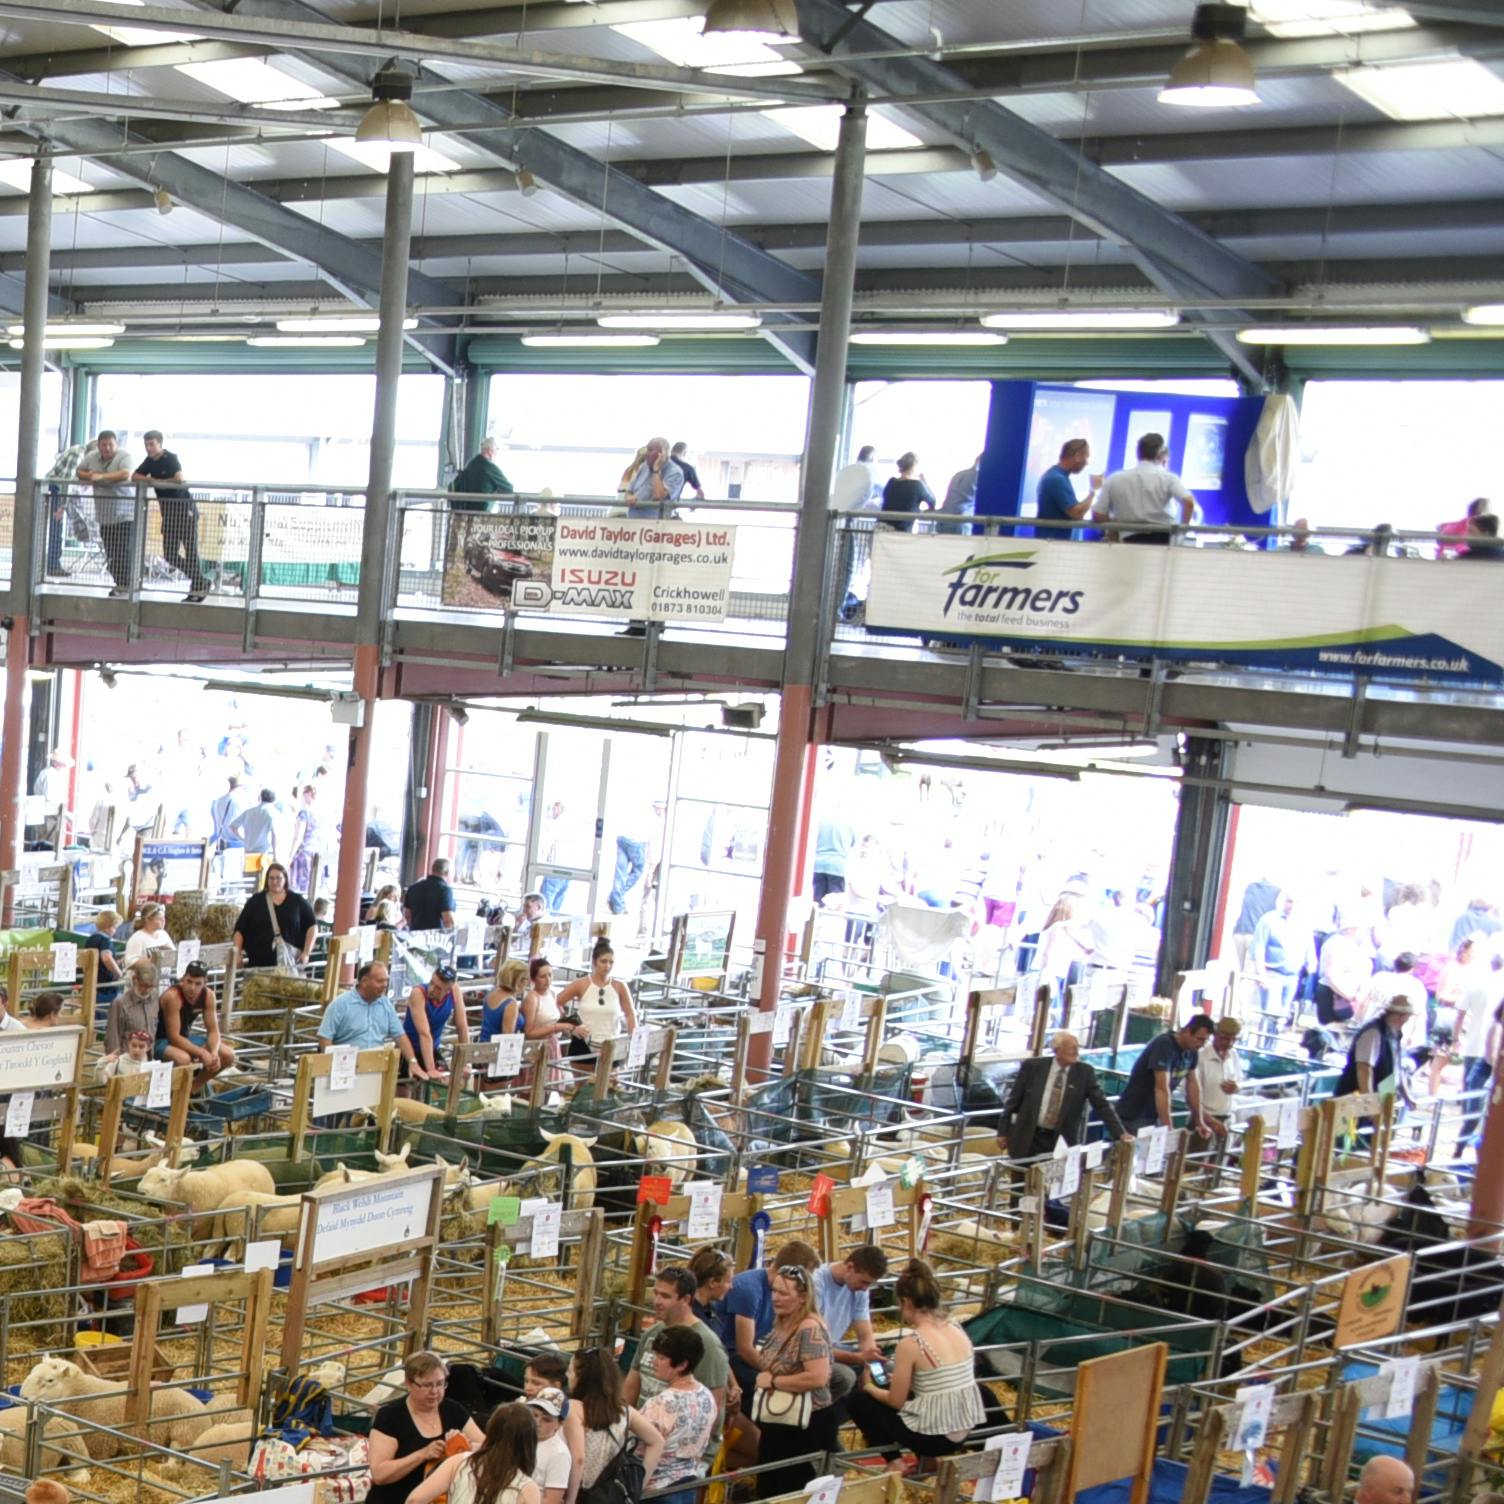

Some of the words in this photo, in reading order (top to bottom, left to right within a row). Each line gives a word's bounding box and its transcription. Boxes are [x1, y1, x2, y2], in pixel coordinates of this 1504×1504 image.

[560, 525, 598, 540] David
[600, 527, 637, 543] Taylor
[640, 527, 702, 548] (Garages)
[705, 532, 731, 547] Ltd.
[559, 546, 729, 565] www.davidtaylorgarages.co.uk
[560, 567, 637, 588] ISUZU
[973, 566, 1000, 585] for
[512, 577, 634, 610] D-MAX
[653, 585, 725, 602] Crickhowell
[944, 557, 1084, 617] farmers
[650, 602, 684, 615] 01873
[685, 603, 723, 616] 810304
[1318, 647, 1470, 674] www.forfarmers.co.uk
[26, 1040, 54, 1052] Cheviot
[353, 1195, 372, 1209] Welsh
